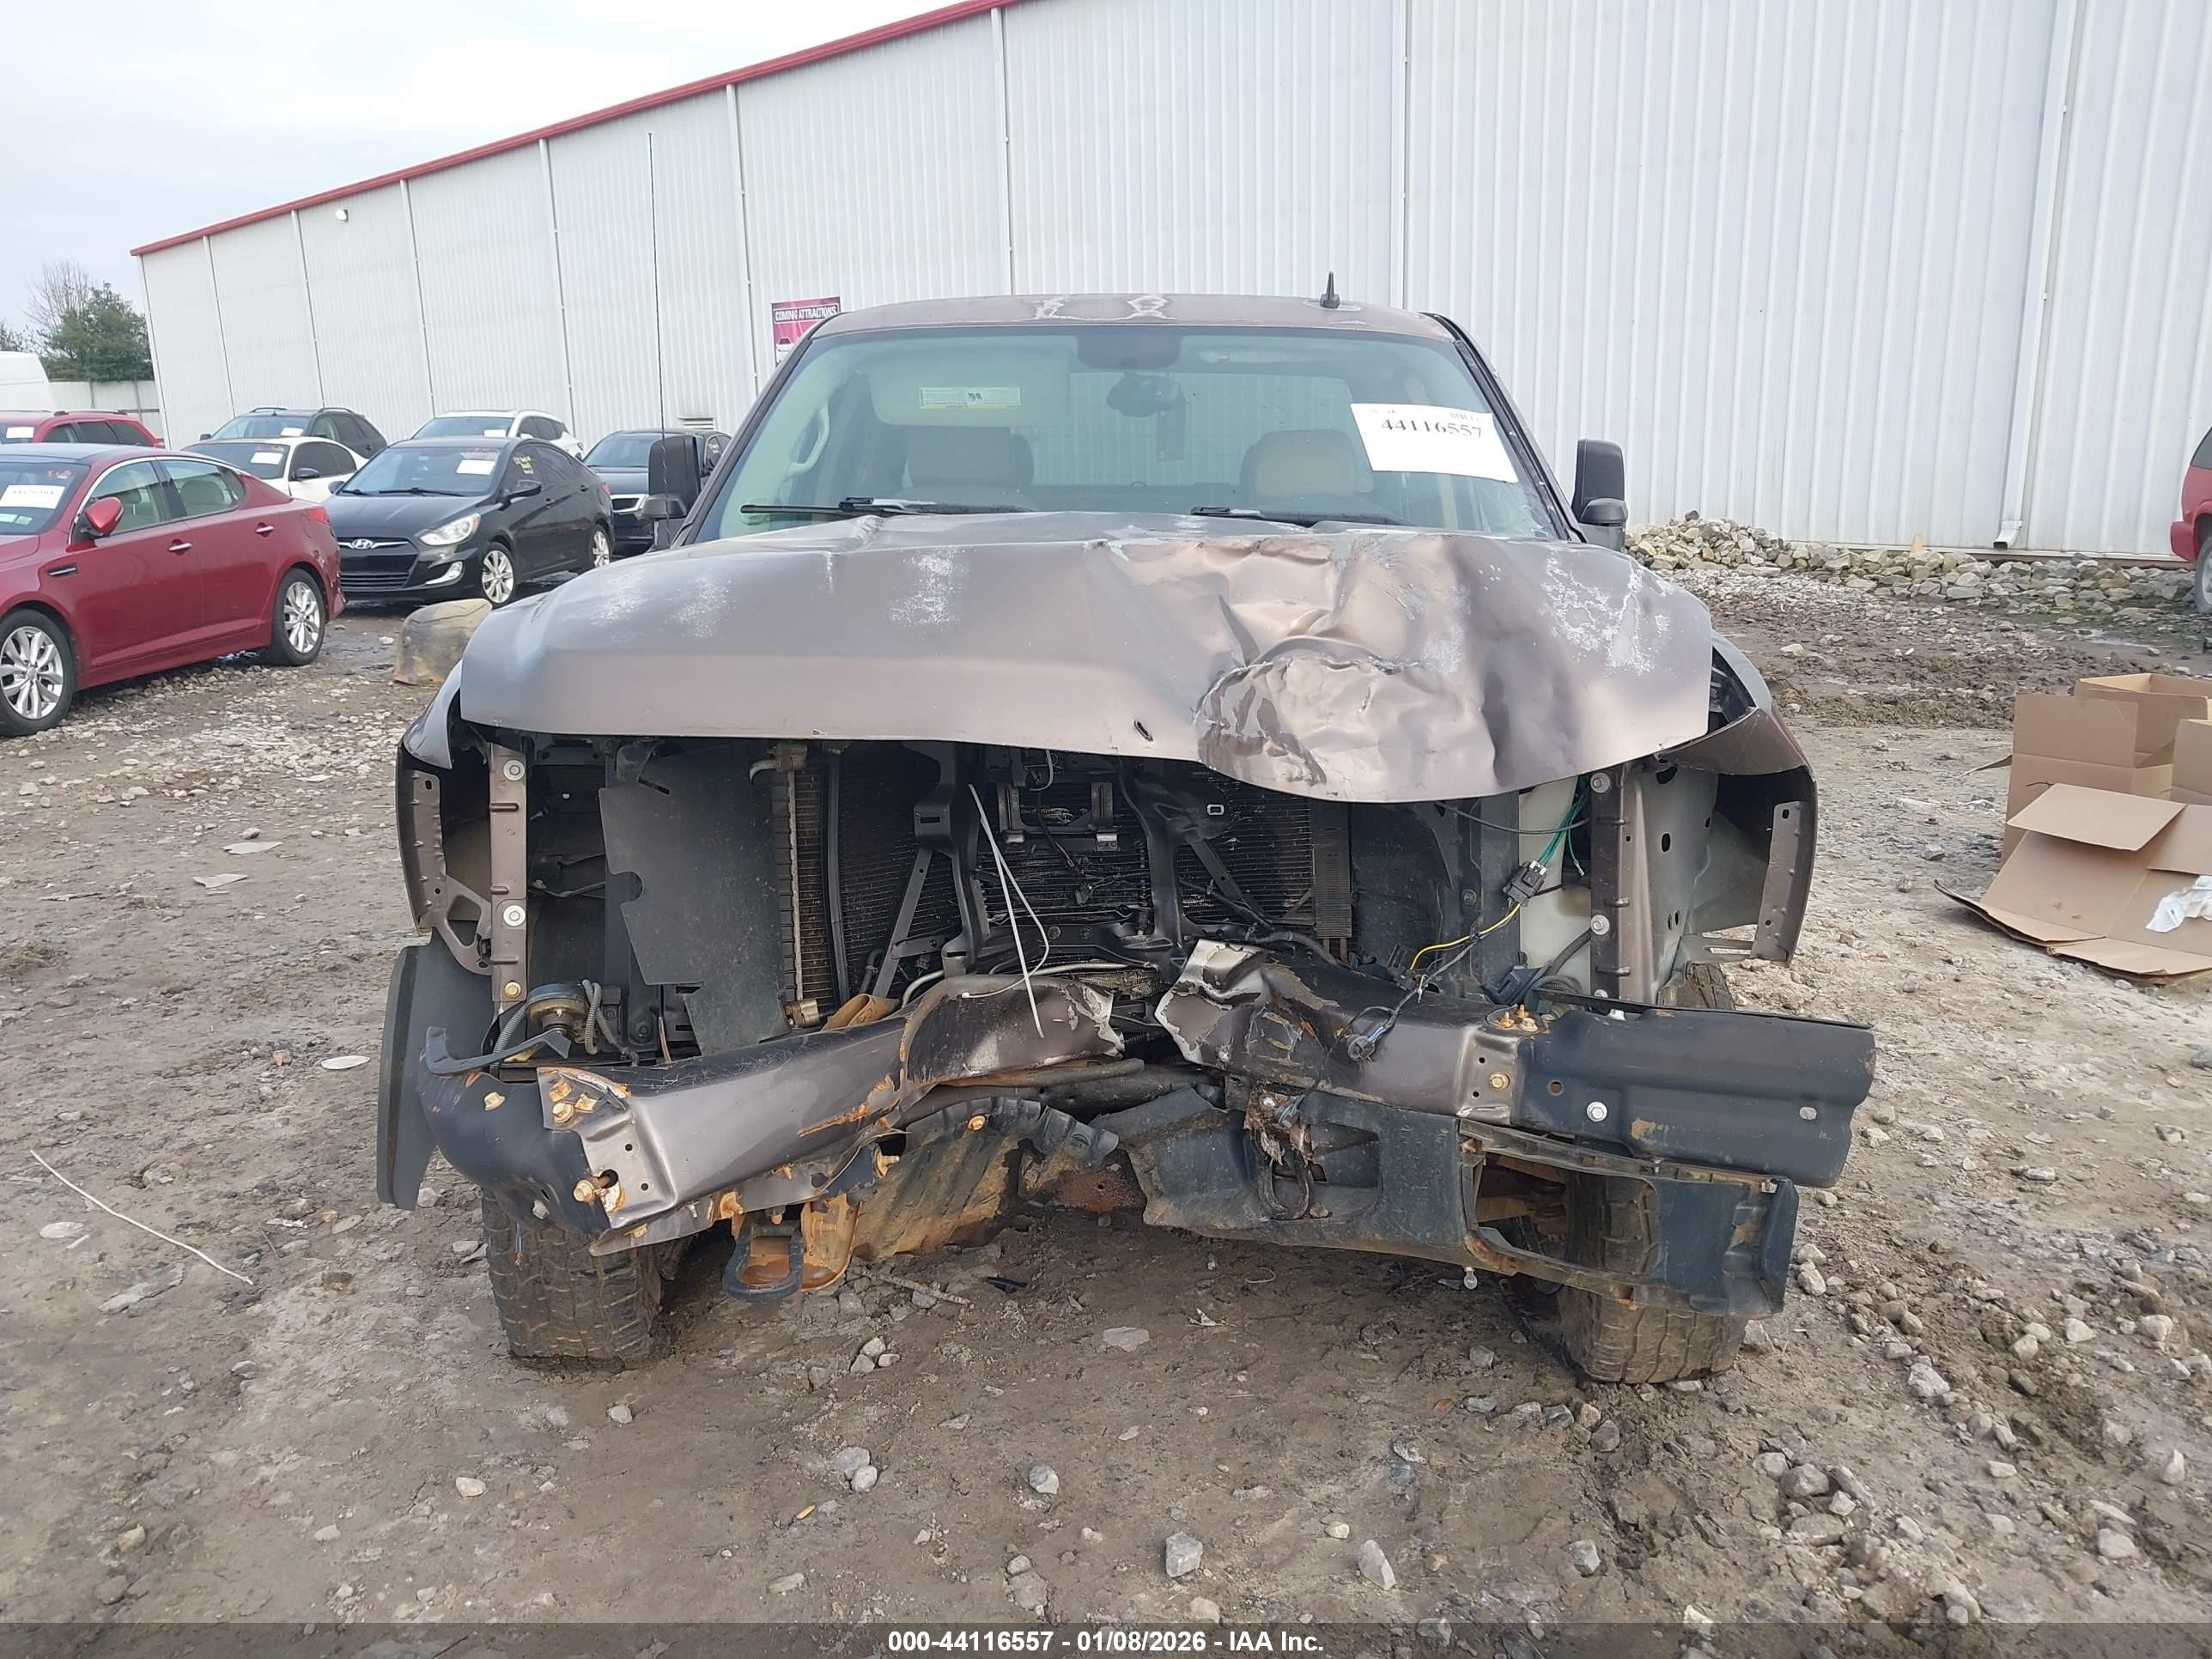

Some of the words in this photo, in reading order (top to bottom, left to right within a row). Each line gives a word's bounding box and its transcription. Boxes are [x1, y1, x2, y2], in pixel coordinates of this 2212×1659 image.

[775, 309, 799, 322] COMING
[799, 306, 837, 321] ATTRACTIONS
[1381, 419, 1482, 439] 44116557
